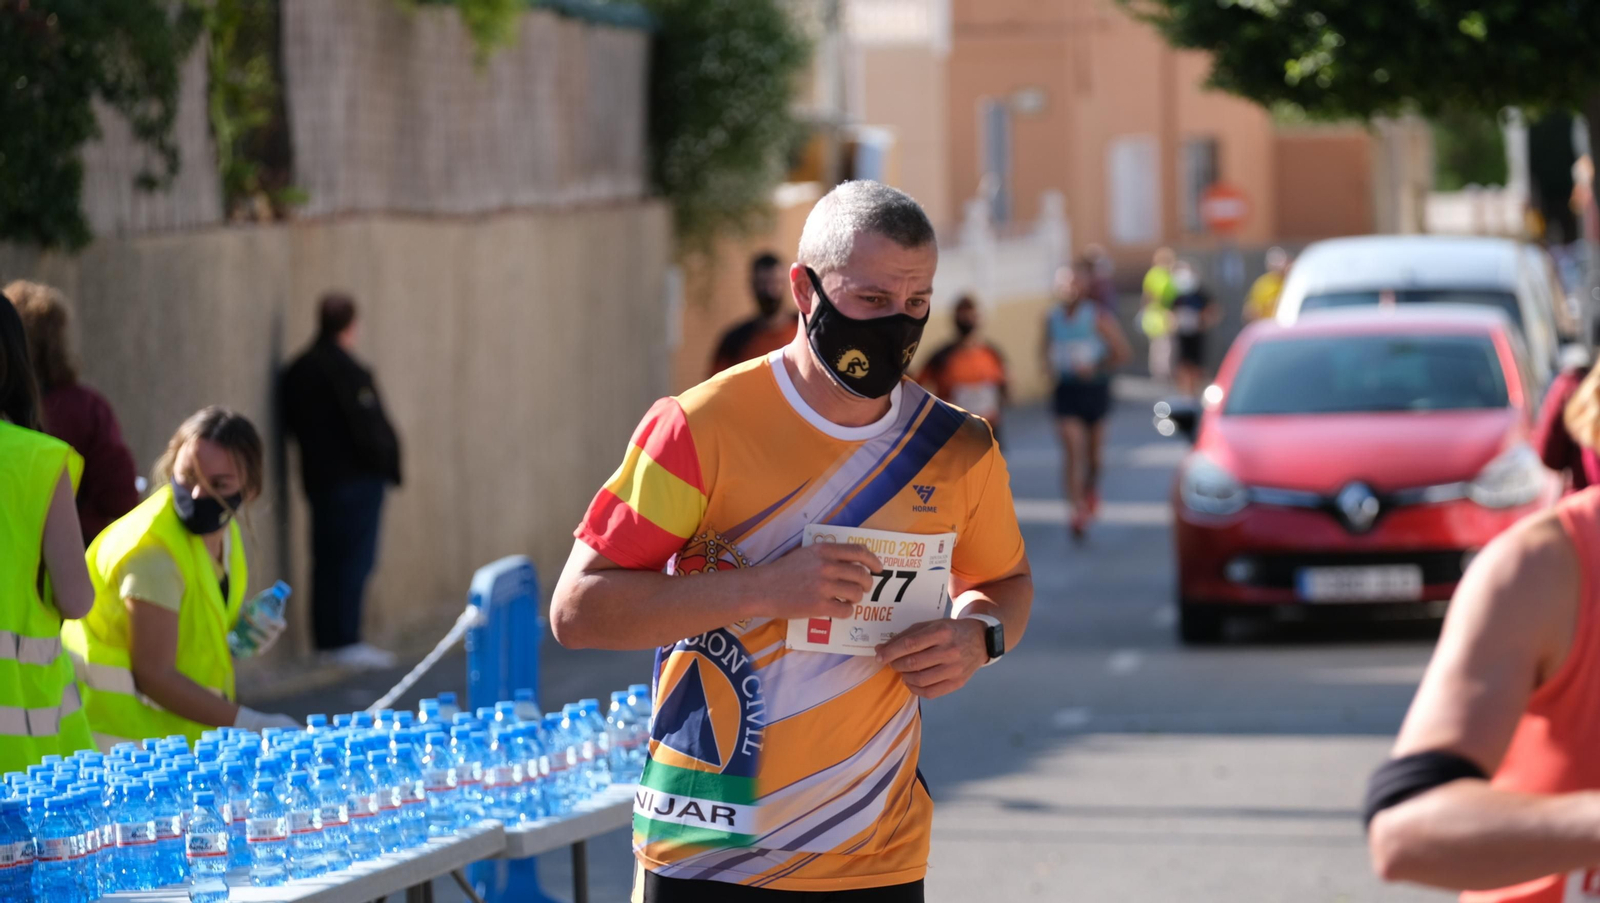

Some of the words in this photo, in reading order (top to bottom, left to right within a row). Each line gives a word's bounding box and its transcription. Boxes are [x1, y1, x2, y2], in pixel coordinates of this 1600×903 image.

[912, 505, 937, 513] HORME
[898, 541, 925, 557] 2020
[883, 557, 922, 568] POPULARES
[854, 604, 894, 622] PONCE
[741, 675, 767, 756] CIVIL
[636, 791, 737, 827] NIJAR
